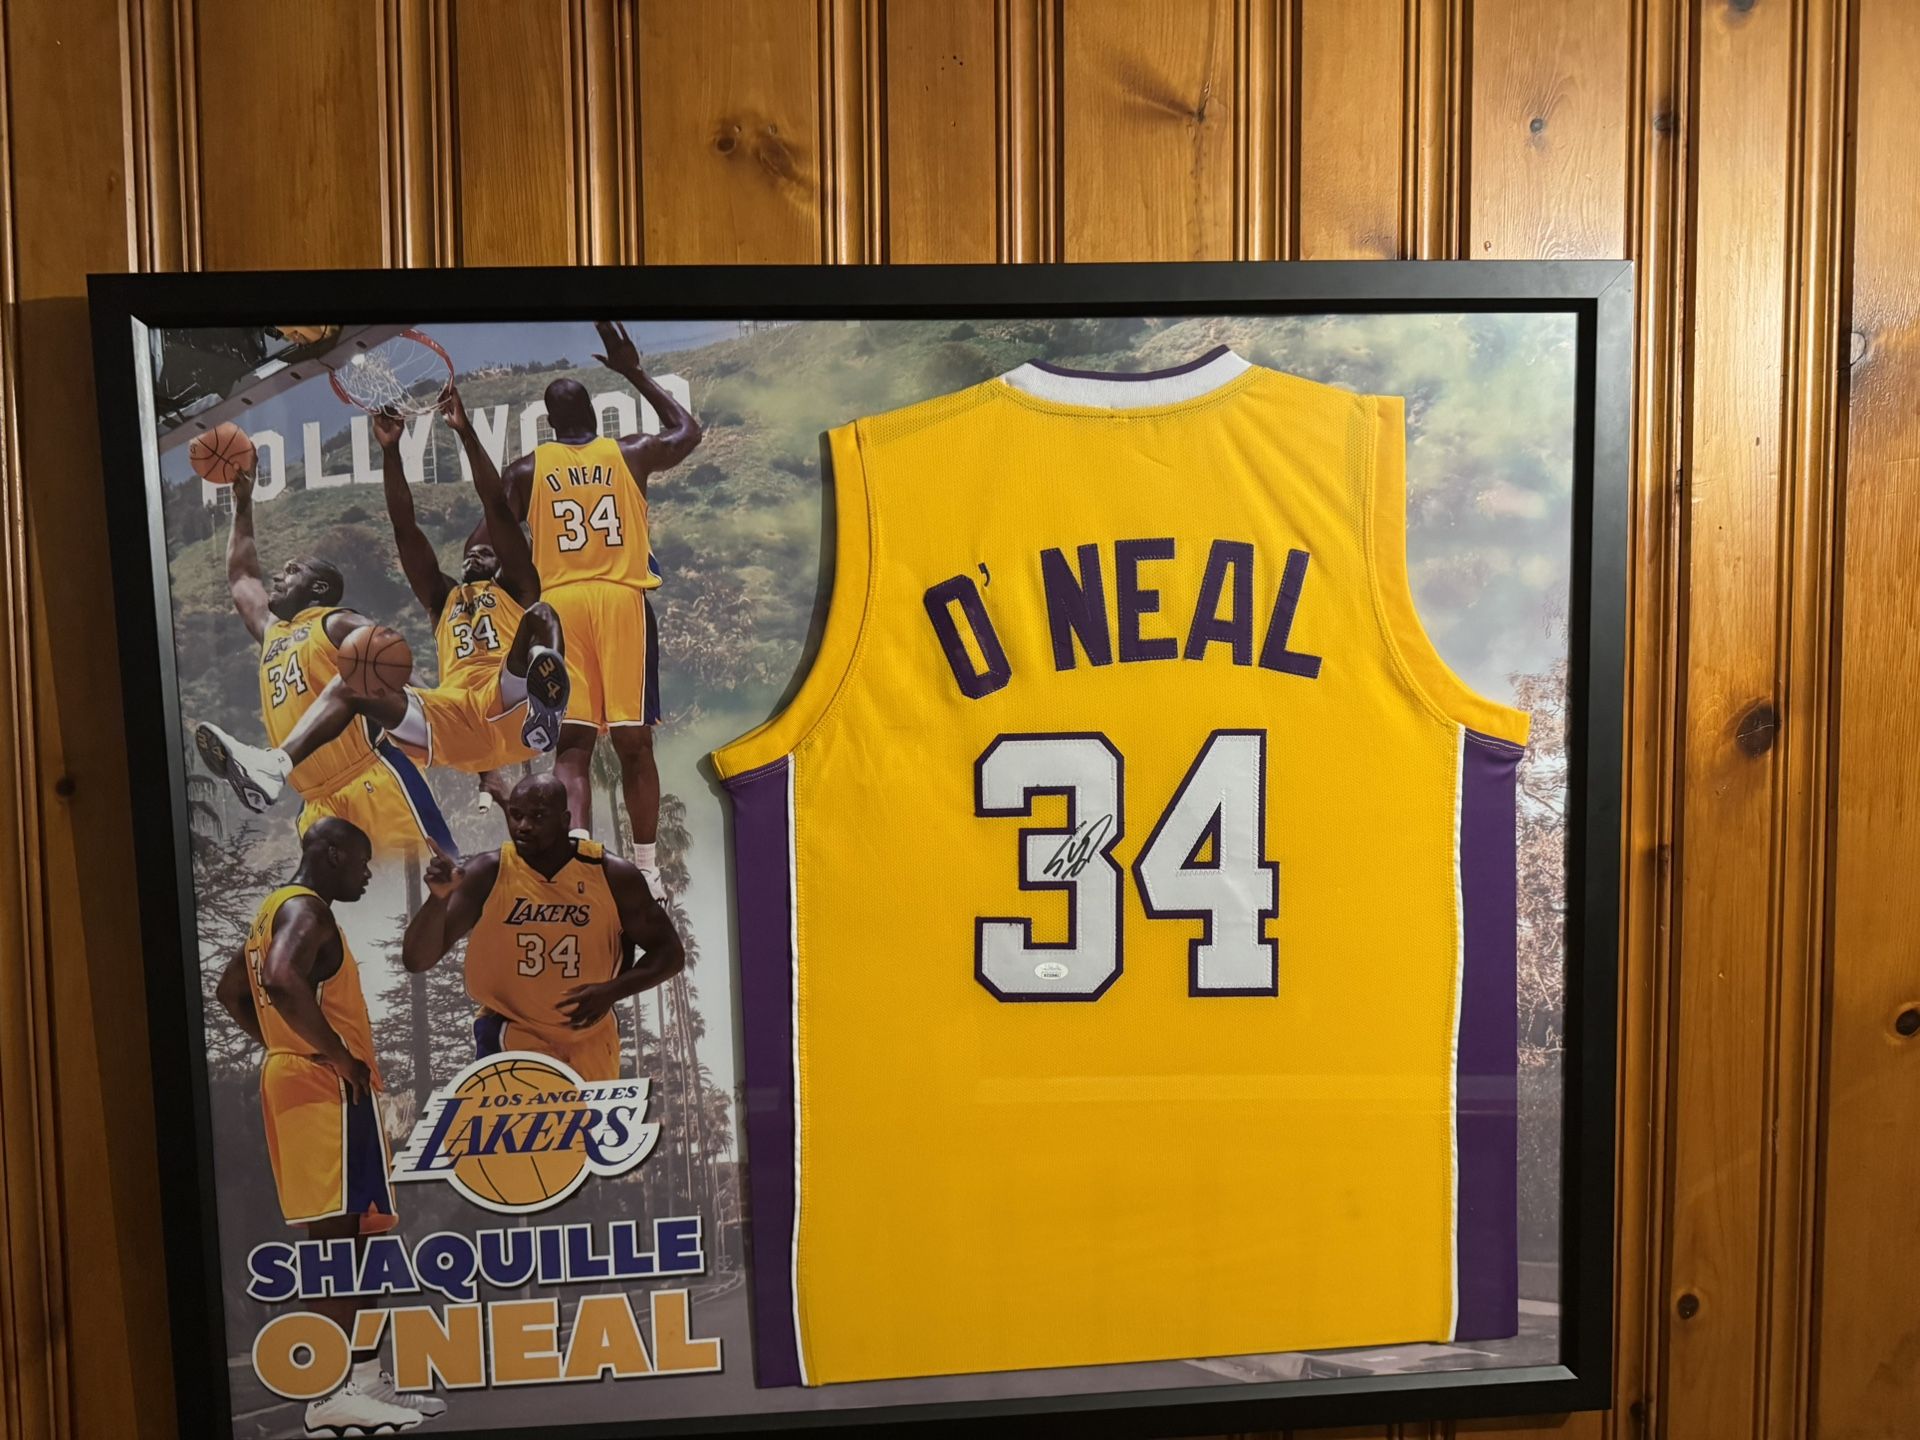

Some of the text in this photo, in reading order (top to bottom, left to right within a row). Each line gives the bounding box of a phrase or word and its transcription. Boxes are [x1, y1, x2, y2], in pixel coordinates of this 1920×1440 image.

[546, 465, 612, 492] O'NEAL
[552, 494, 624, 553] 34
[453, 614, 500, 659] 34
[923, 537, 1323, 700] O'NEAL
[267, 650, 308, 709] 34
[974, 728, 1280, 1003] 34
[503, 897, 591, 927] LAKERS
[516, 933, 580, 978] 34
[478, 1085, 640, 1108] LOS ANGELES
[403, 1097, 648, 1172] LAKERS
[246, 1216, 705, 1303] SHAQUILLE
[252, 1289, 722, 1400] O'NEAL
